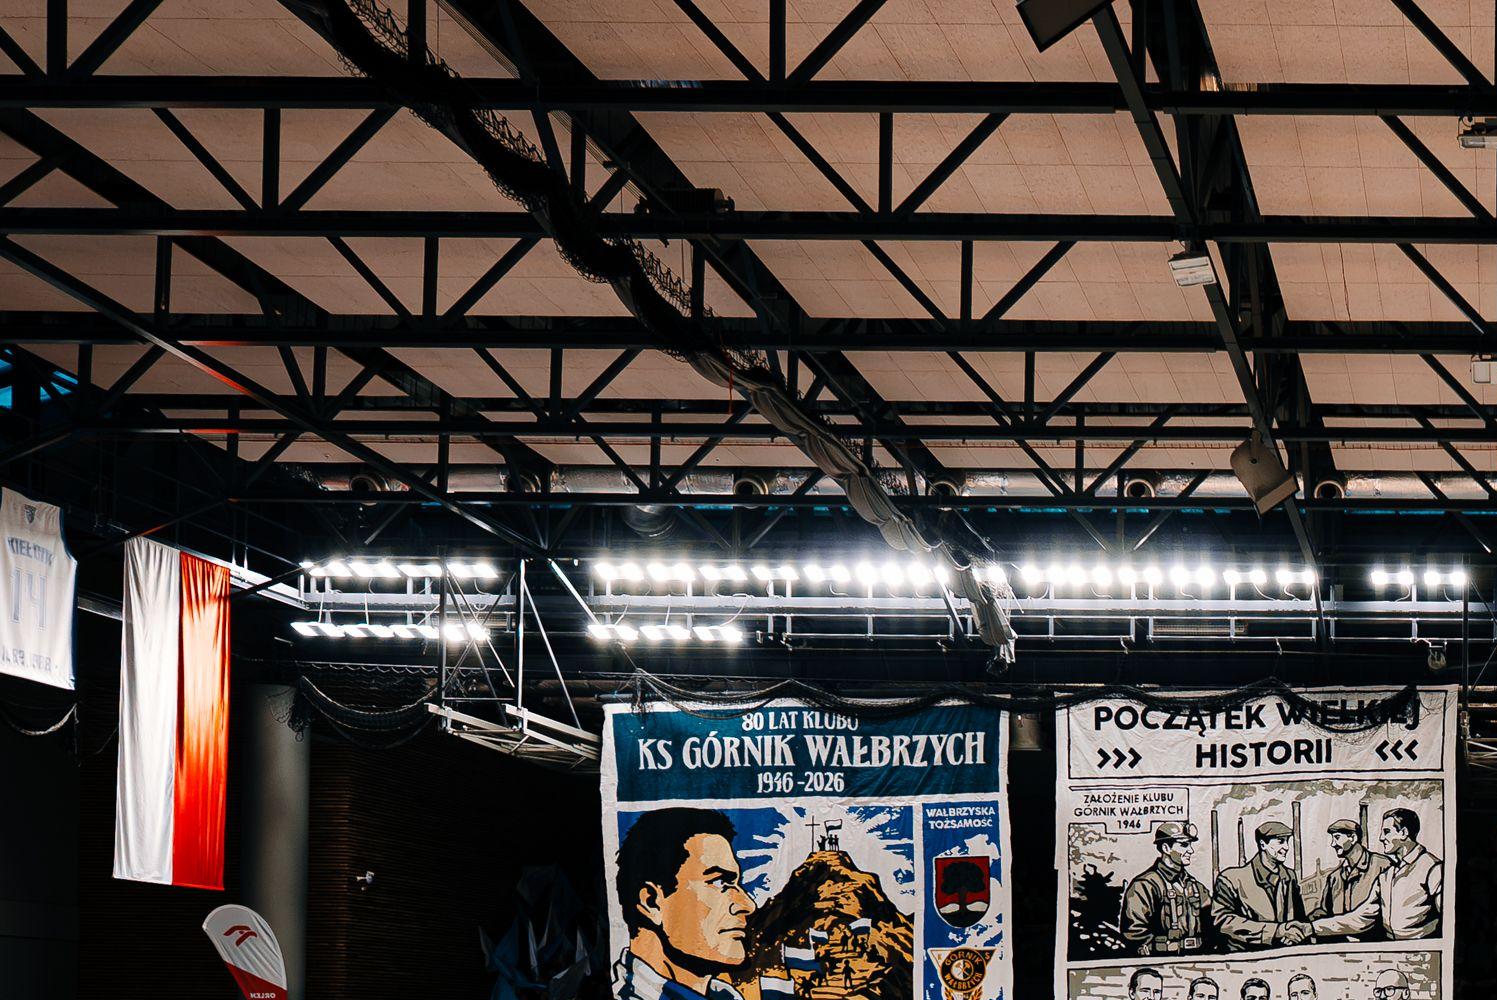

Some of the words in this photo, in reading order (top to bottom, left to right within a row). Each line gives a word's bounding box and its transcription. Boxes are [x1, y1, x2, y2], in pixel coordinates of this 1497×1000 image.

[742, 713, 764, 730] 80
[769, 712, 799, 729] LAT
[1094, 703, 1266, 736] POCZĄTEK
[638, 739, 672, 770] KS
[683, 731, 795, 768] GÓRNIK
[805, 732, 985, 767] WAŁBRZYCH
[1195, 738, 1332, 769] HISTORII
[1084, 793, 1140, 804] ZAŁOŻENIE
[1142, 792, 1174, 802] KLUBU
[1074, 804, 1117, 817] GÓRNIK
[1120, 805, 1183, 816] WAŁBRZYCH
[1117, 819, 1141, 830] 1946
